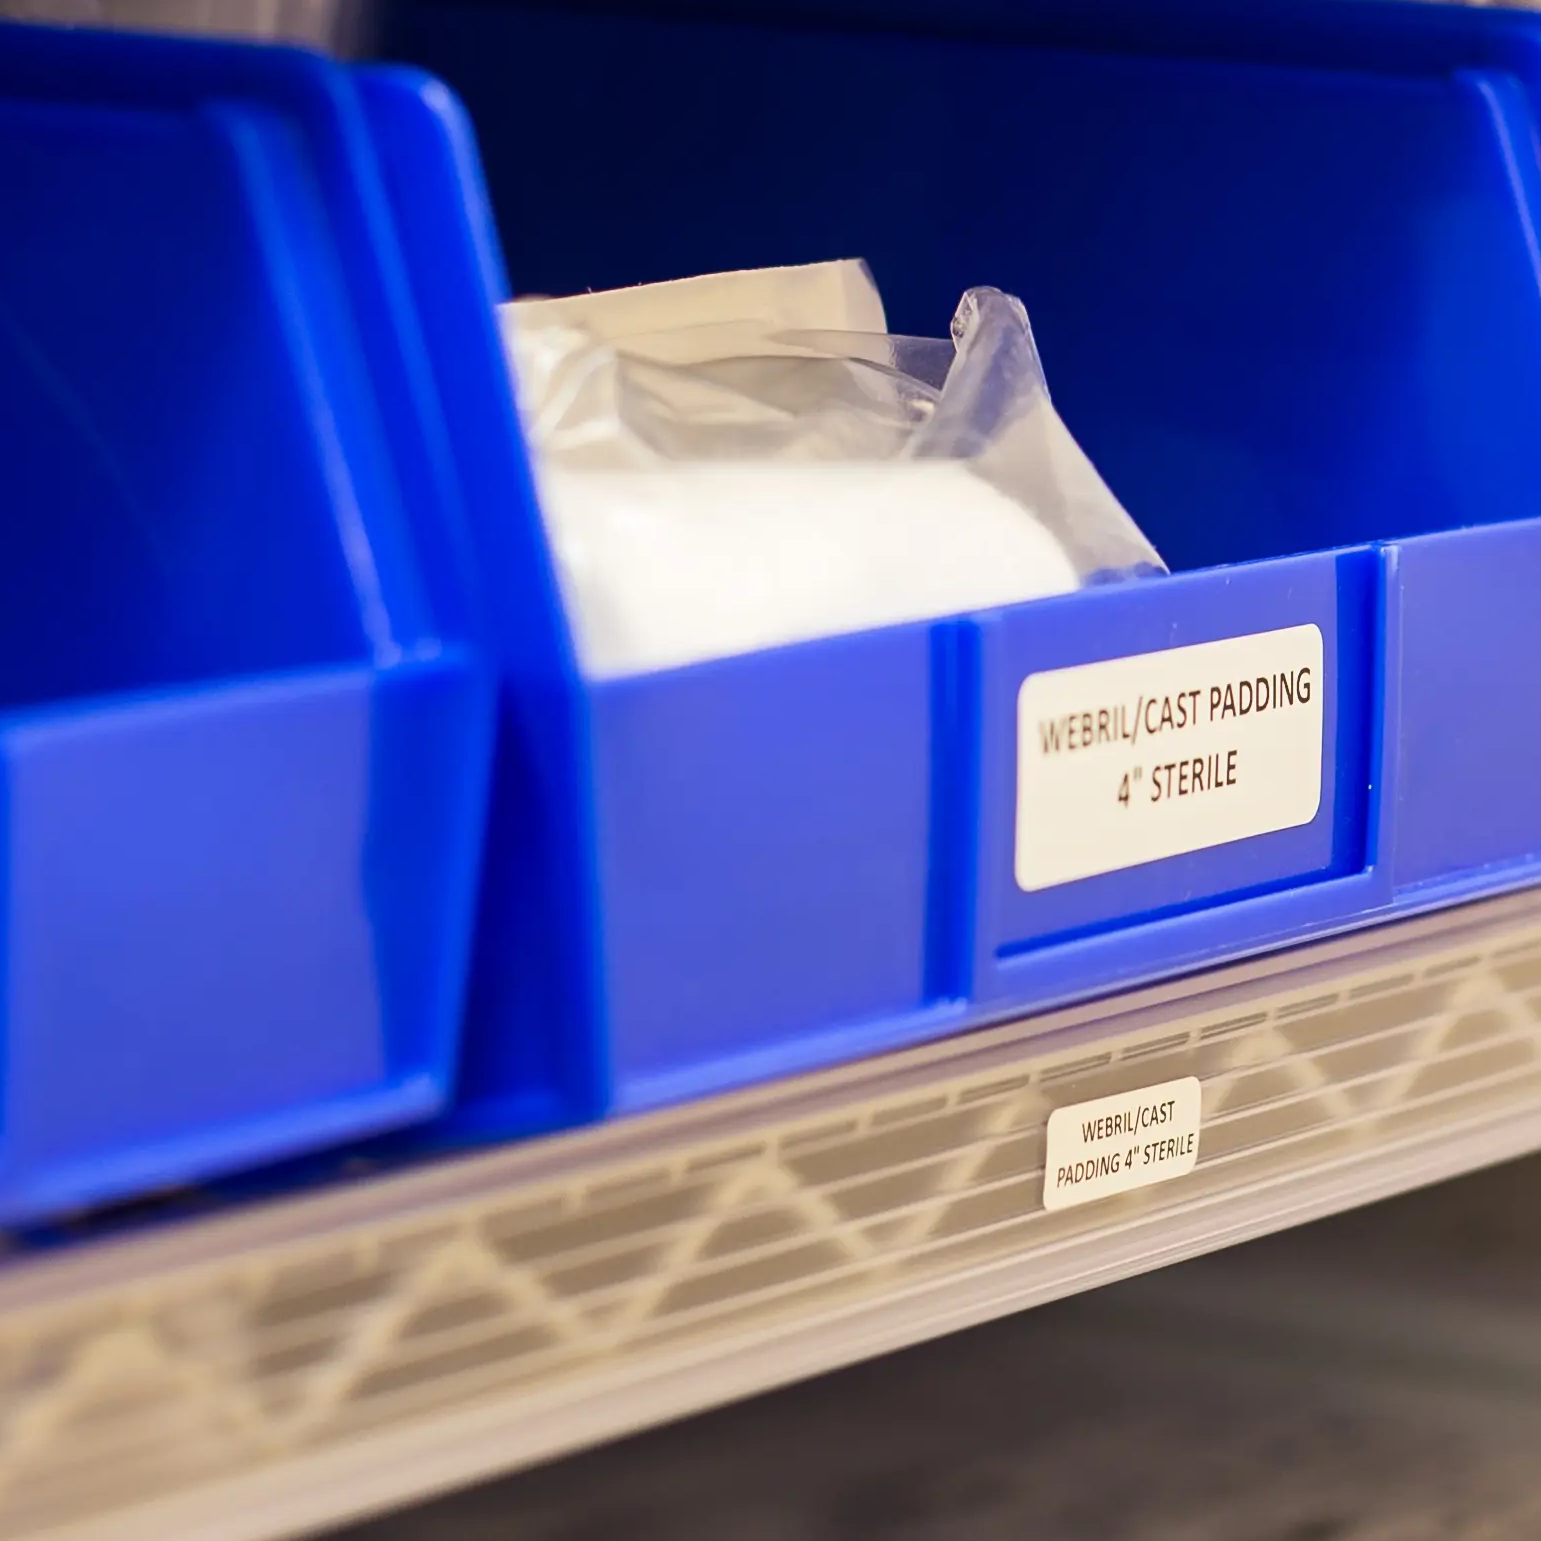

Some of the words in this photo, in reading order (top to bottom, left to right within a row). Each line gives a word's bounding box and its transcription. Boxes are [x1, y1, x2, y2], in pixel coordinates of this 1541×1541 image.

[1038, 689, 1202, 757] WEBRIL/CAST
[1209, 666, 1312, 723] PADDING
[1117, 766, 1144, 809] 4"
[1150, 749, 1238, 804] STERILE
[1081, 1100, 1176, 1144] WEBRIL/CAST
[1056, 1152, 1121, 1189] PADDING
[1124, 1144, 1141, 1170] 4"
[1142, 1132, 1195, 1166] STERILE
